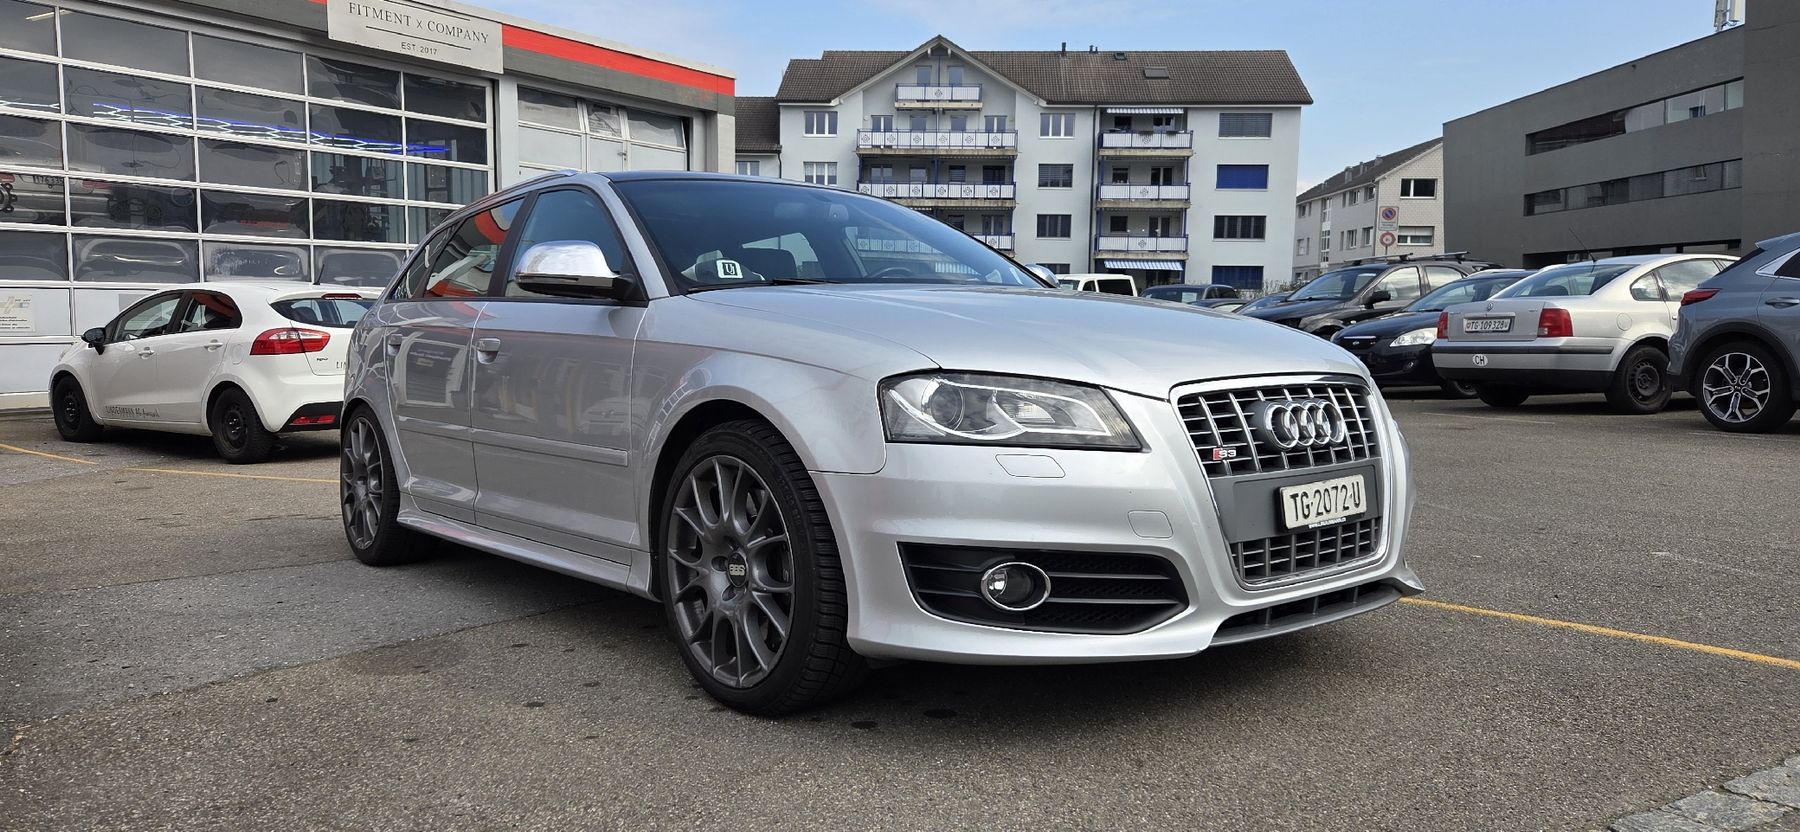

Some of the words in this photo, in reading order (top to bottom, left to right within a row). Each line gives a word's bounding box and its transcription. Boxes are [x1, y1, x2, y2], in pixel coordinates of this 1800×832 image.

[349, 2, 411, 27] FITMENT
[427, 20, 489, 44] COMPANY
[401, 41, 419, 51] EST.
[420, 46, 438, 56] 2017
[1474, 355, 1485, 365] CH
[1219, 449, 1237, 458] S3
[729, 563, 746, 576] BBS
